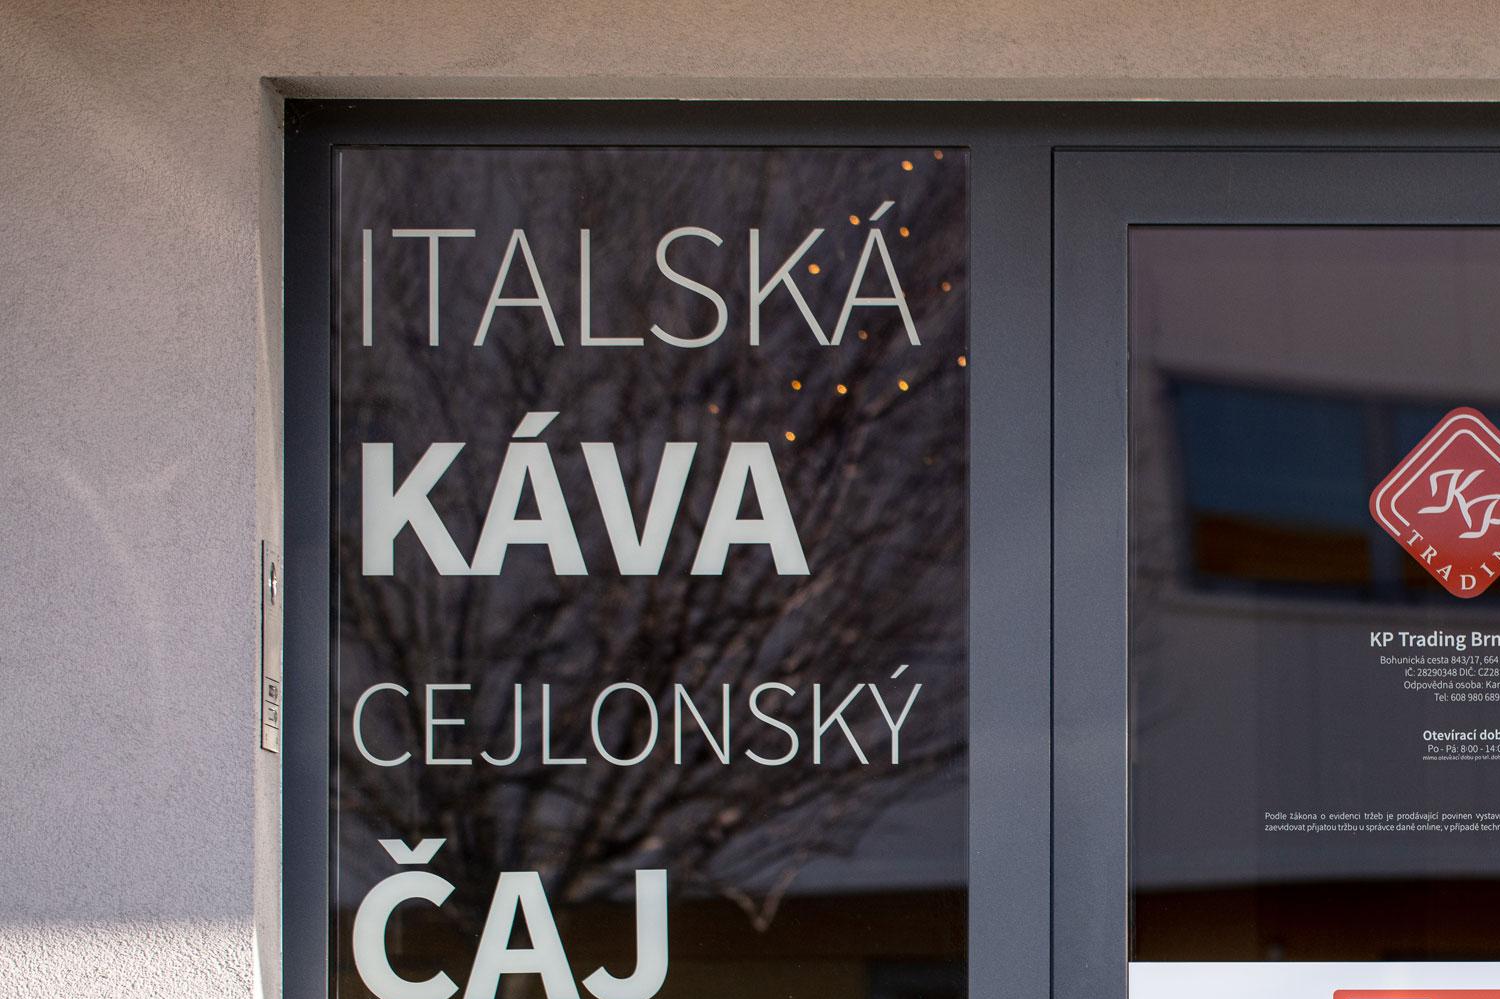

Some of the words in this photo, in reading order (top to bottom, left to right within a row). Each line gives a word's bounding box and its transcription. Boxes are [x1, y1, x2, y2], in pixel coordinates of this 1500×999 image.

[362, 200, 922, 348] ITALSKÁ
[362, 411, 811, 576] KÁVA
[1370, 631, 1394, 648] KP
[1398, 630, 1467, 652] Trading
[1380, 655, 1426, 666] Bohunická
[1426, 657, 1449, 665] cesta
[1450, 655, 1483, 666] 843/17,
[1483, 655, 1499, 665] 664
[1404, 666, 1416, 677] IČ:
[1416, 668, 1458, 678] 28290348
[1403, 680, 1454, 692] Odpovědná
[1454, 680, 1485, 690] osoba:
[1433, 692, 1449, 702] Tel:
[1450, 692, 1467, 702] 608
[1467, 692, 1484, 702] 980
[1484, 692, 1500, 702] 689
[352, 664, 923, 767] CEJLONSKÝ
[1422, 728, 1478, 741] Otevírací
[1427, 744, 1440, 753] Po
[1445, 744, 1459, 753] Pá:
[1264, 811, 1288, 821] Podle
[1328, 811, 1361, 821] evidenci
[1363, 811, 1384, 821] tržeb
[1386, 811, 1394, 822] je
[1396, 811, 1440, 822] prodávající
[1441, 811, 1475, 822] povinen
[1264, 822, 1306, 832] zaevidovat
[1306, 822, 1337, 833] přijatou
[1338, 822, 1358, 832] tržbu
[1365, 822, 1395, 833] správce
[1396, 822, 1416, 832] daně
[1449, 822, 1480, 833] případě
